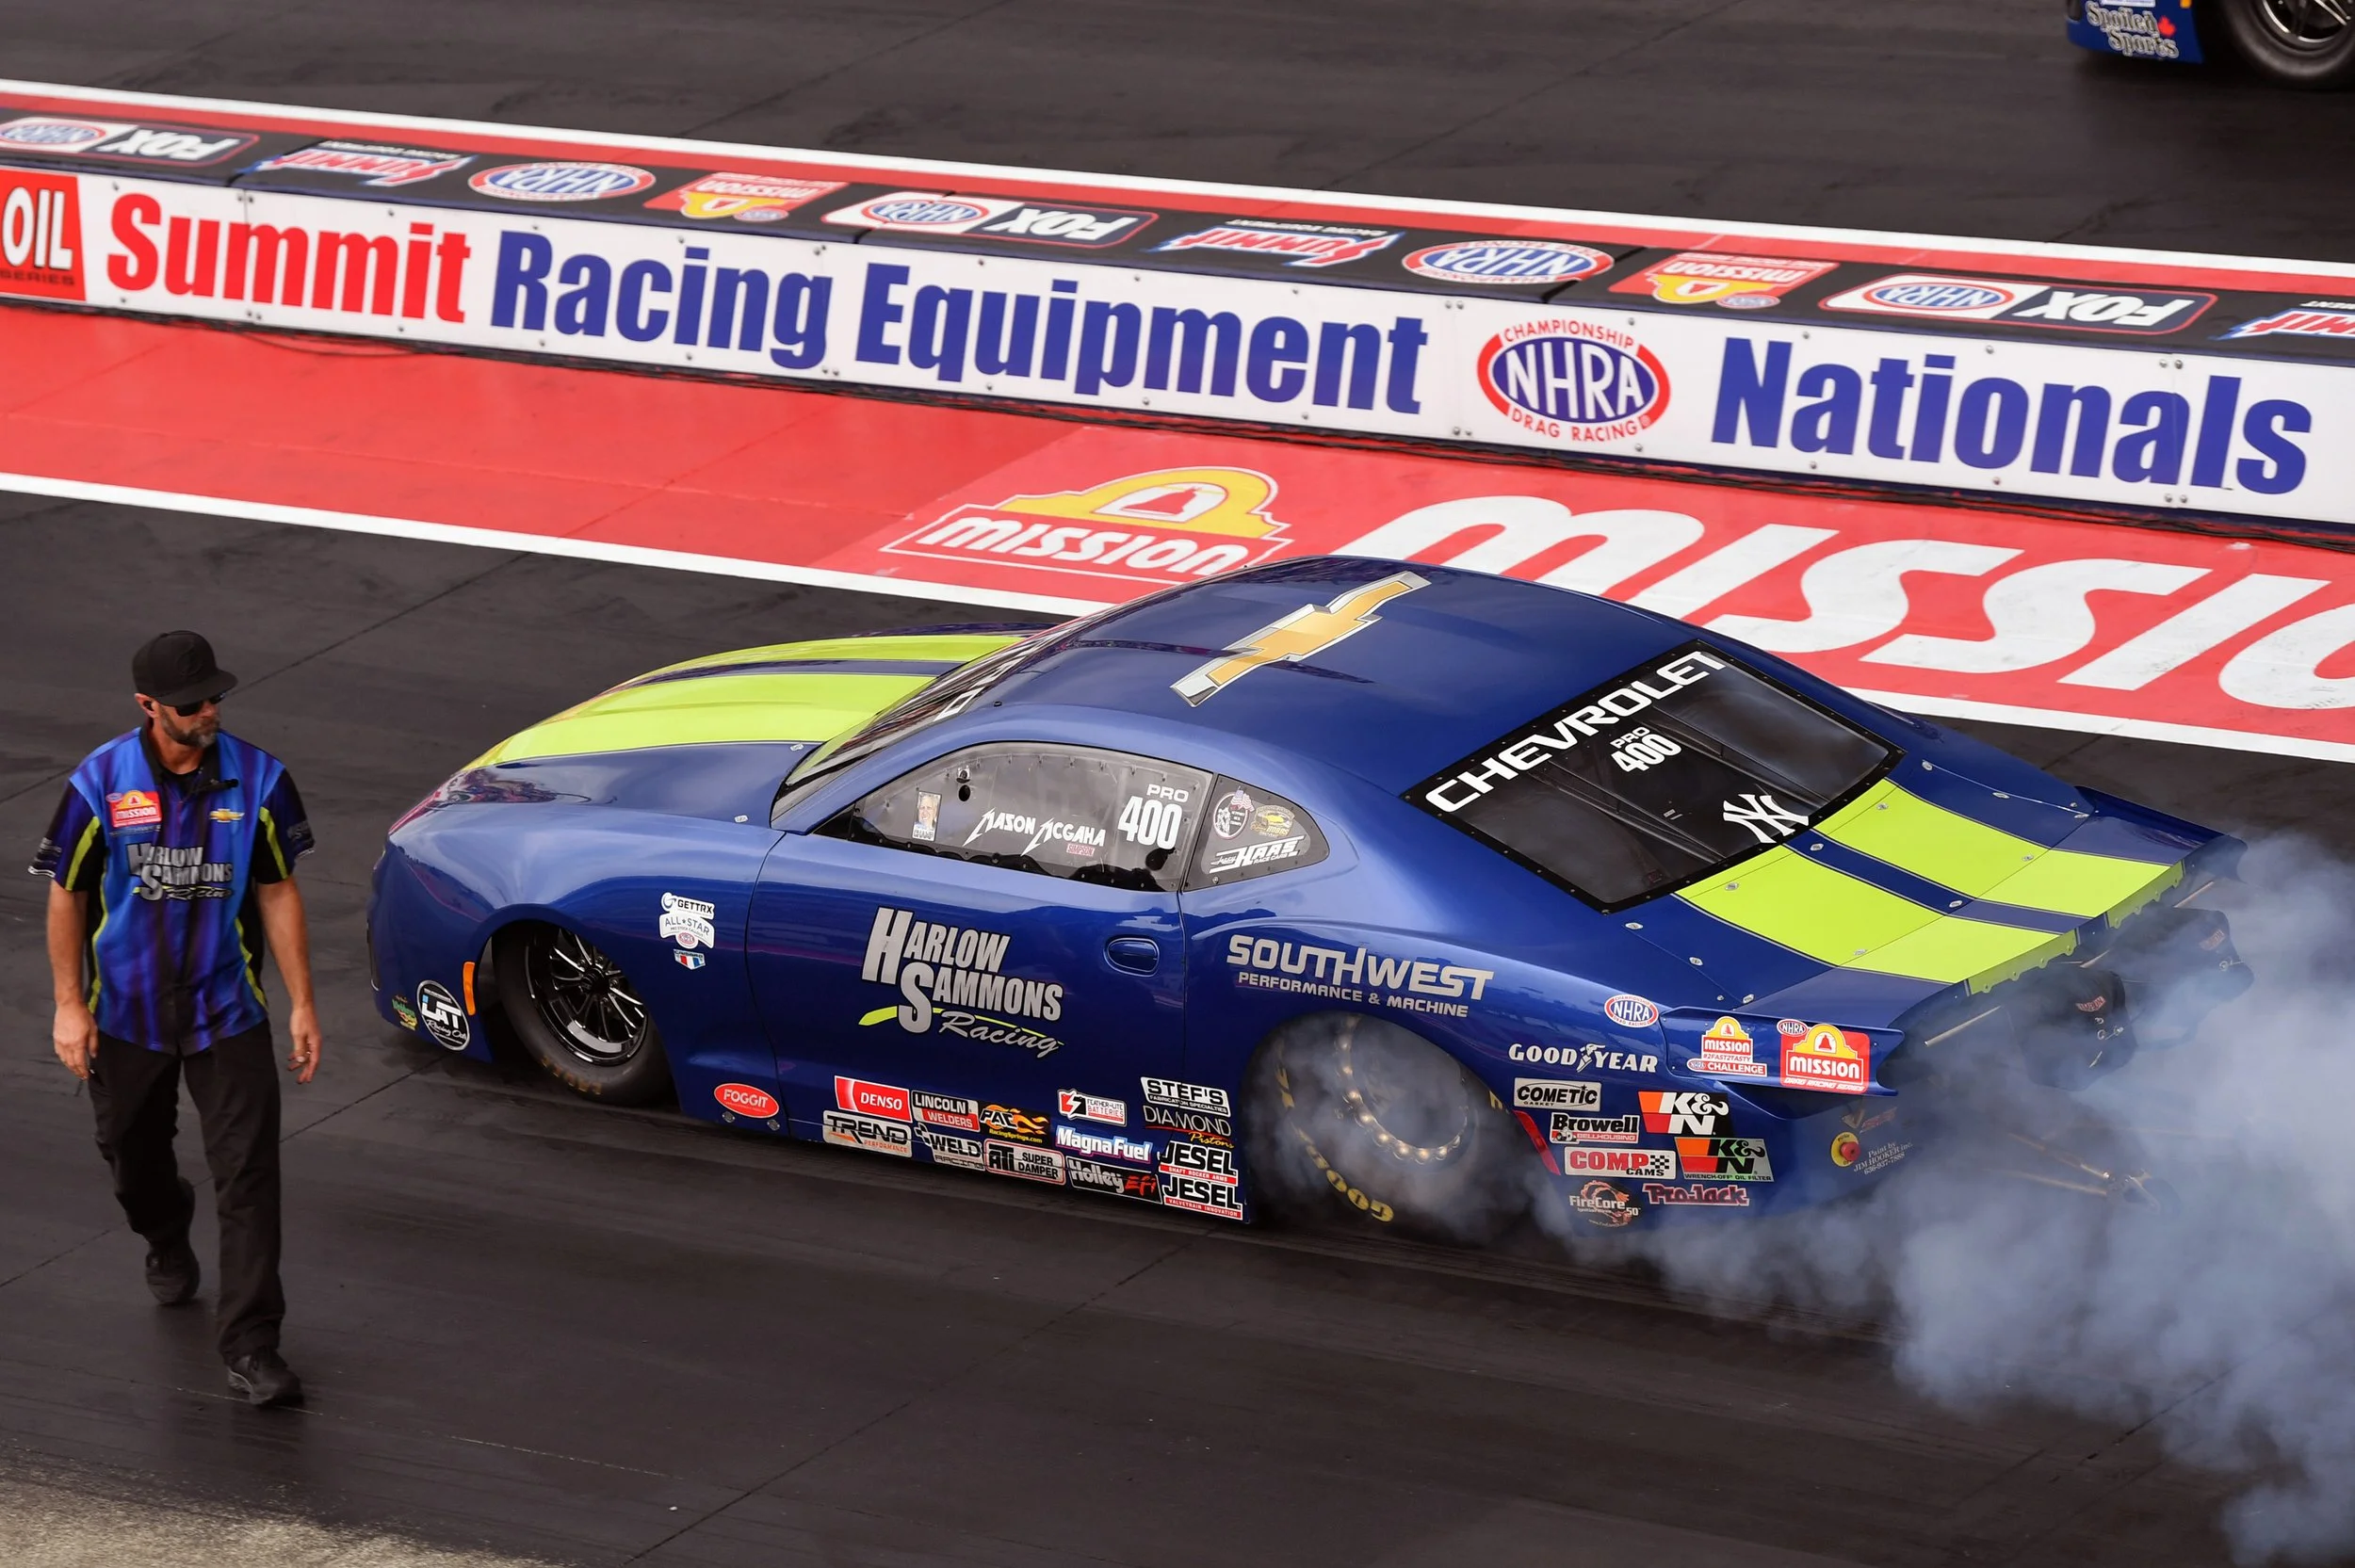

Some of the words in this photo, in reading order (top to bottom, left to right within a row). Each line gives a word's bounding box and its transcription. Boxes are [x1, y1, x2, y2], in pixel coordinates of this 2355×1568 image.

[2085, 1, 2160, 36] Spoiled
[2107, 27, 2180, 58] Sports
[97, 130, 240, 160] FOX
[2, 186, 73, 270] OIL
[983, 208, 1138, 240] FOX
[1434, 246, 1586, 278] NHRA
[106, 192, 470, 323] Summit
[491, 231, 833, 370] Racing
[855, 262, 1428, 414] Equipment
[2016, 291, 2195, 327] FOX
[1504, 319, 1633, 349] CHAMPIONSHIP
[1505, 341, 1645, 420] NHRA
[1511, 408, 1560, 438] DRAG
[1571, 419, 1637, 442] RACING
[1712, 337, 2313, 495] Nationals
[1425, 651, 1726, 813] CHEVROLET
[1610, 726, 1650, 749] PRO
[1611, 734, 1682, 773] 400
[1146, 784, 1189, 803] PRO
[1117, 795, 1183, 850] 400
[1236, 839, 1299, 866] HAAS
[678, 898, 713, 913] GETTRX
[665, 916, 681, 927] ALL
[688, 917, 710, 935] STAR
[862, 907, 1011, 984] HARLOW
[1226, 934, 1494, 1000] SOUTHWEST
[898, 962, 1064, 1033] SAMMONS
[1238, 971, 1363, 1003] PERFORMANCE
[1368, 993, 1380, 1005] &
[1386, 994, 1470, 1018] MACHINE
[1613, 1000, 1650, 1021] NHRA
[939, 1010, 1061, 1059] Racing
[1780, 1021, 1805, 1034] NHRA
[1708, 1062, 1764, 1075] CHALLENGE
[723, 1089, 769, 1107] FOGGIT
[860, 1091, 902, 1110] DENSO
[915, 1093, 966, 1114] LINCOLN
[1147, 1079, 1224, 1106] STEF'S
[1518, 1084, 1598, 1105] COMETIC
[827, 1115, 907, 1145] TREND
[928, 1111, 973, 1128] WELDERS
[1143, 1106, 1231, 1137] DIAMOND
[1552, 1114, 1637, 1133] Browell
[864, 1140, 908, 1154] PERFORMANCE
[930, 1133, 981, 1157] WELD
[1057, 1127, 1150, 1162] MagnaFuel
[1188, 1131, 1234, 1149] Pistons
[1018, 1161, 1059, 1179] DAMPER
[1022, 1152, 1053, 1166] SUPER
[1159, 1141, 1238, 1176] JESEL
[1169, 1167, 1188, 1175] SHAFT
[1188, 1171, 1210, 1179] ROCKER
[1570, 1151, 1649, 1171] COMP
[1626, 1168, 1665, 1176] CAMS
[1068, 1158, 1125, 1194] Holley
[1163, 1176, 1242, 1210] JESEL
[1569, 1196, 1626, 1209] FireCore
[1205, 1205, 1238, 1217] INNOVATION
